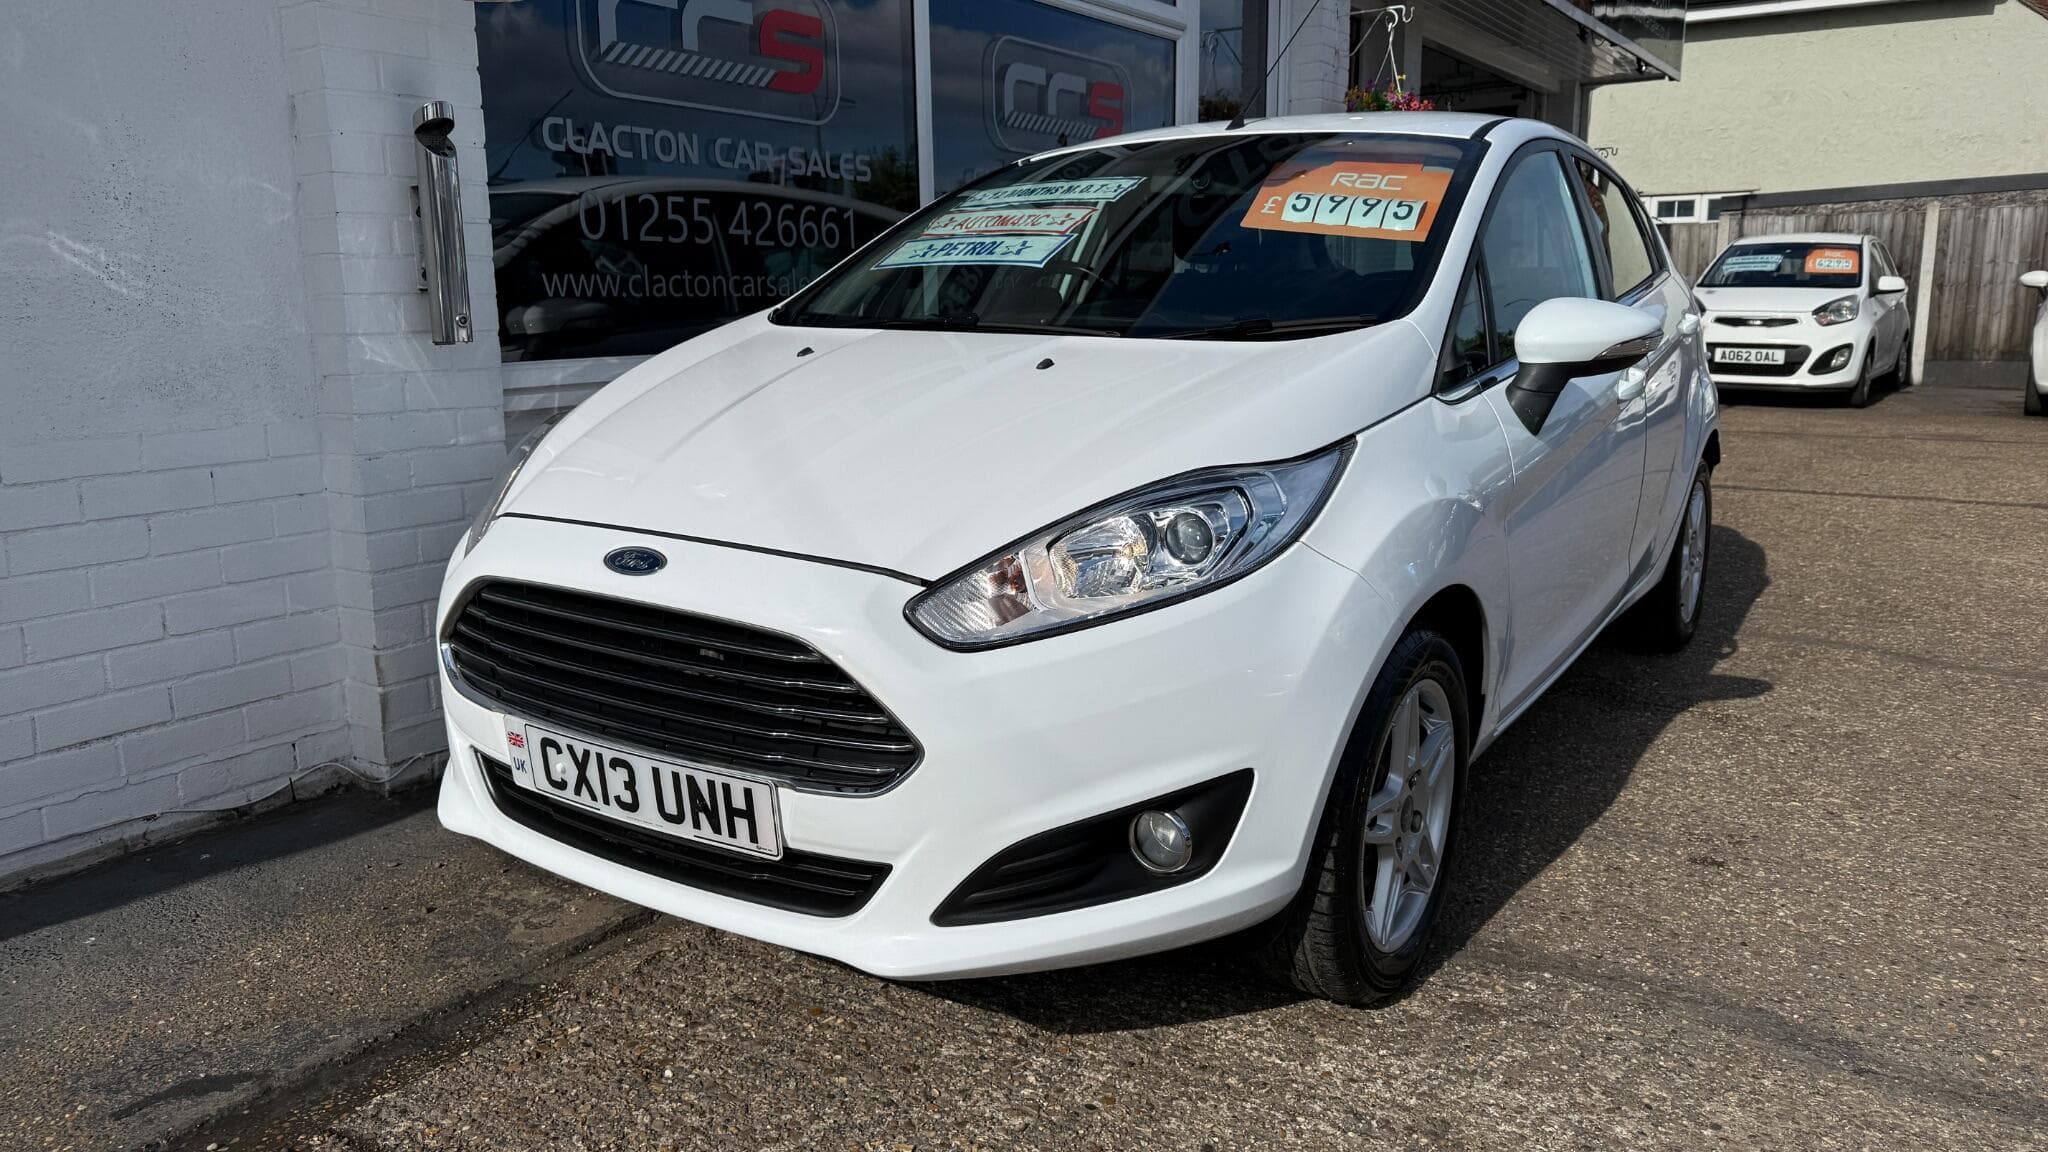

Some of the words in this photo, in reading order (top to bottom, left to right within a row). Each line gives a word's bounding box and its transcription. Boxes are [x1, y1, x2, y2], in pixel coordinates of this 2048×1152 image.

[541, 116, 699, 164] CLACTON
[714, 137, 777, 174] CAR
[787, 146, 873, 183] SALES
[1004, 185, 1064, 199] MONTHS
[1291, 193, 1415, 221] 5995
[579, 192, 714, 246] 01255
[728, 200, 858, 250] 426661
[954, 213, 1050, 230] AUTOMATIC
[932, 240, 1004, 259] PETROL
[1720, 350, 1752, 361] AO62
[1755, 351, 1779, 363] OAL
[513, 756, 527, 774] UK
[540, 737, 640, 814] CX13
[651, 766, 759, 845] UNH
